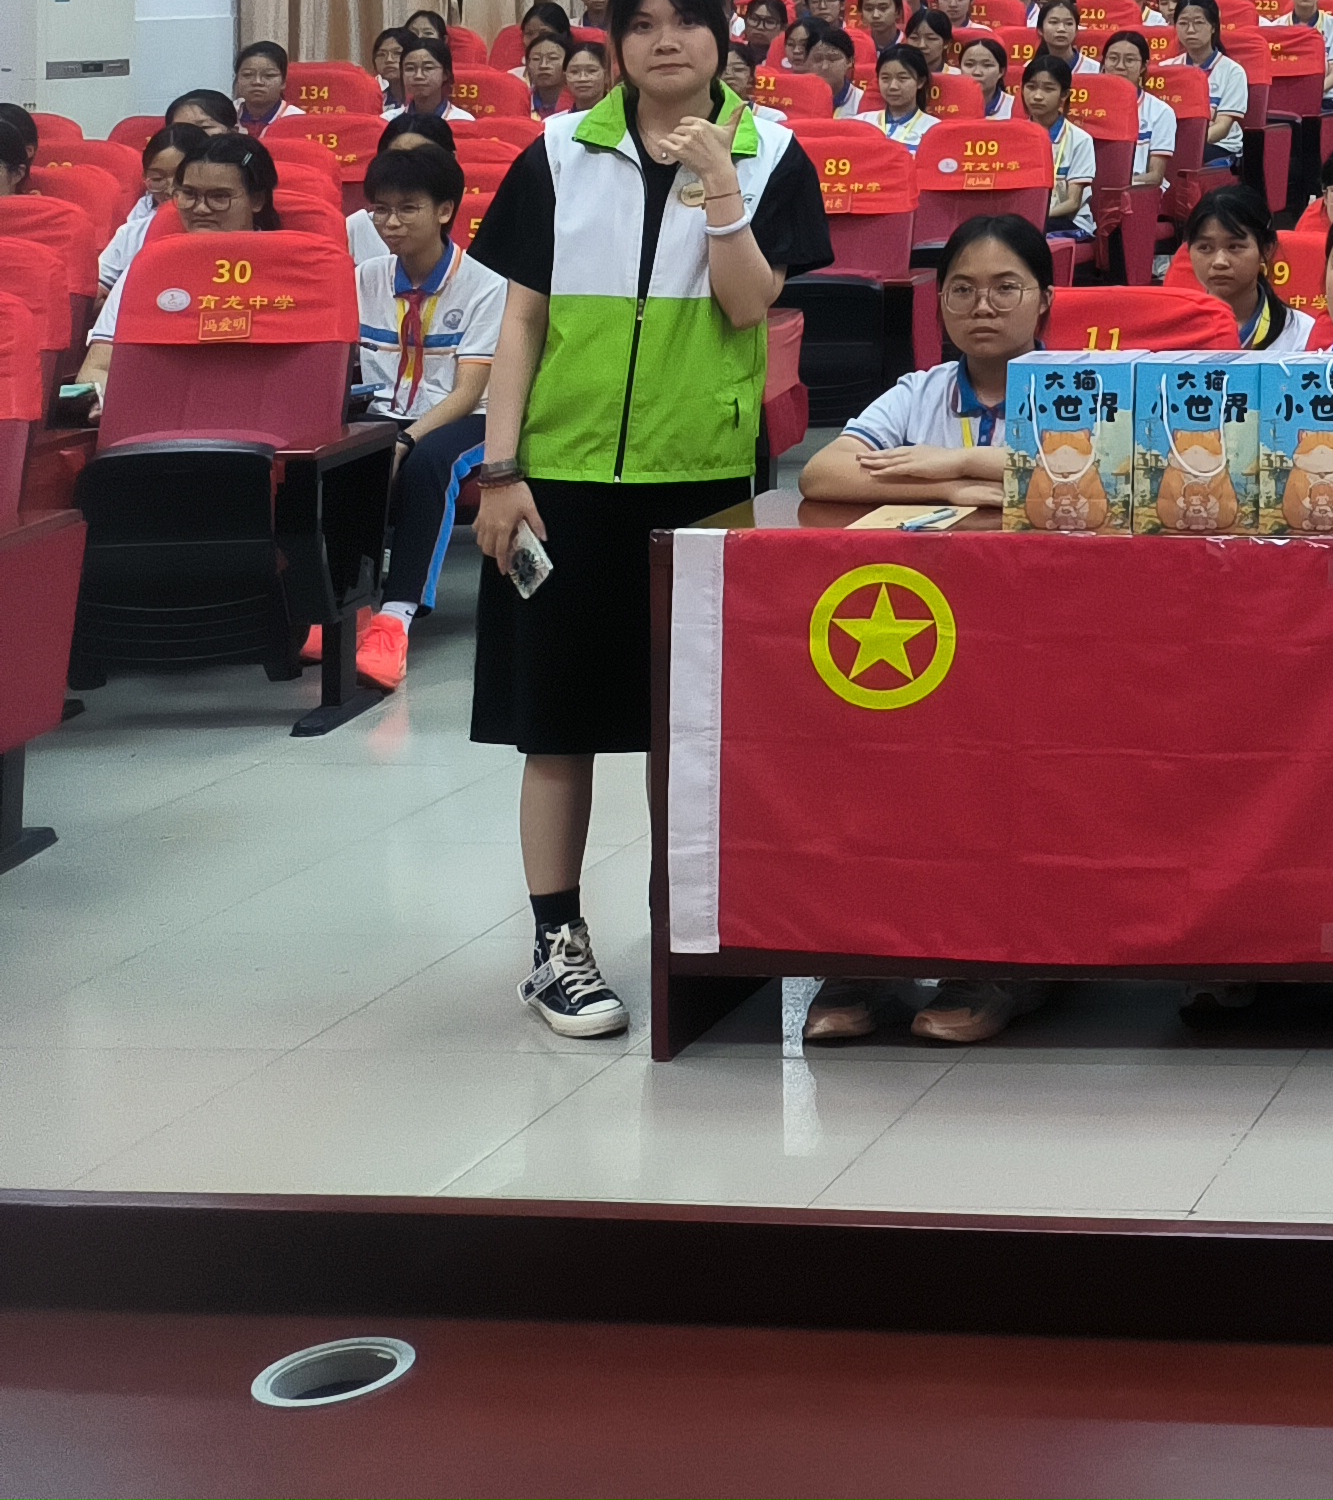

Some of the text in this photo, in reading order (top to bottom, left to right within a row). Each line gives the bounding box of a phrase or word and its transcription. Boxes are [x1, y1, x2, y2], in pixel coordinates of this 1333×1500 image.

[1080, 8, 1106, 19] 210
[1255, 0, 1279, 11] 229
[299, 85, 330, 100] 134
[963, 140, 999, 156] 109
[824, 158, 851, 176] 89
[212, 258, 253, 284] 30
[1082, 326, 1121, 351] 11
[1044, 368, 1099, 391] 大猫
[1176, 368, 1227, 391] 大猫
[1018, 392, 1119, 423] 小世界
[1151, 392, 1248, 423] 小世界
